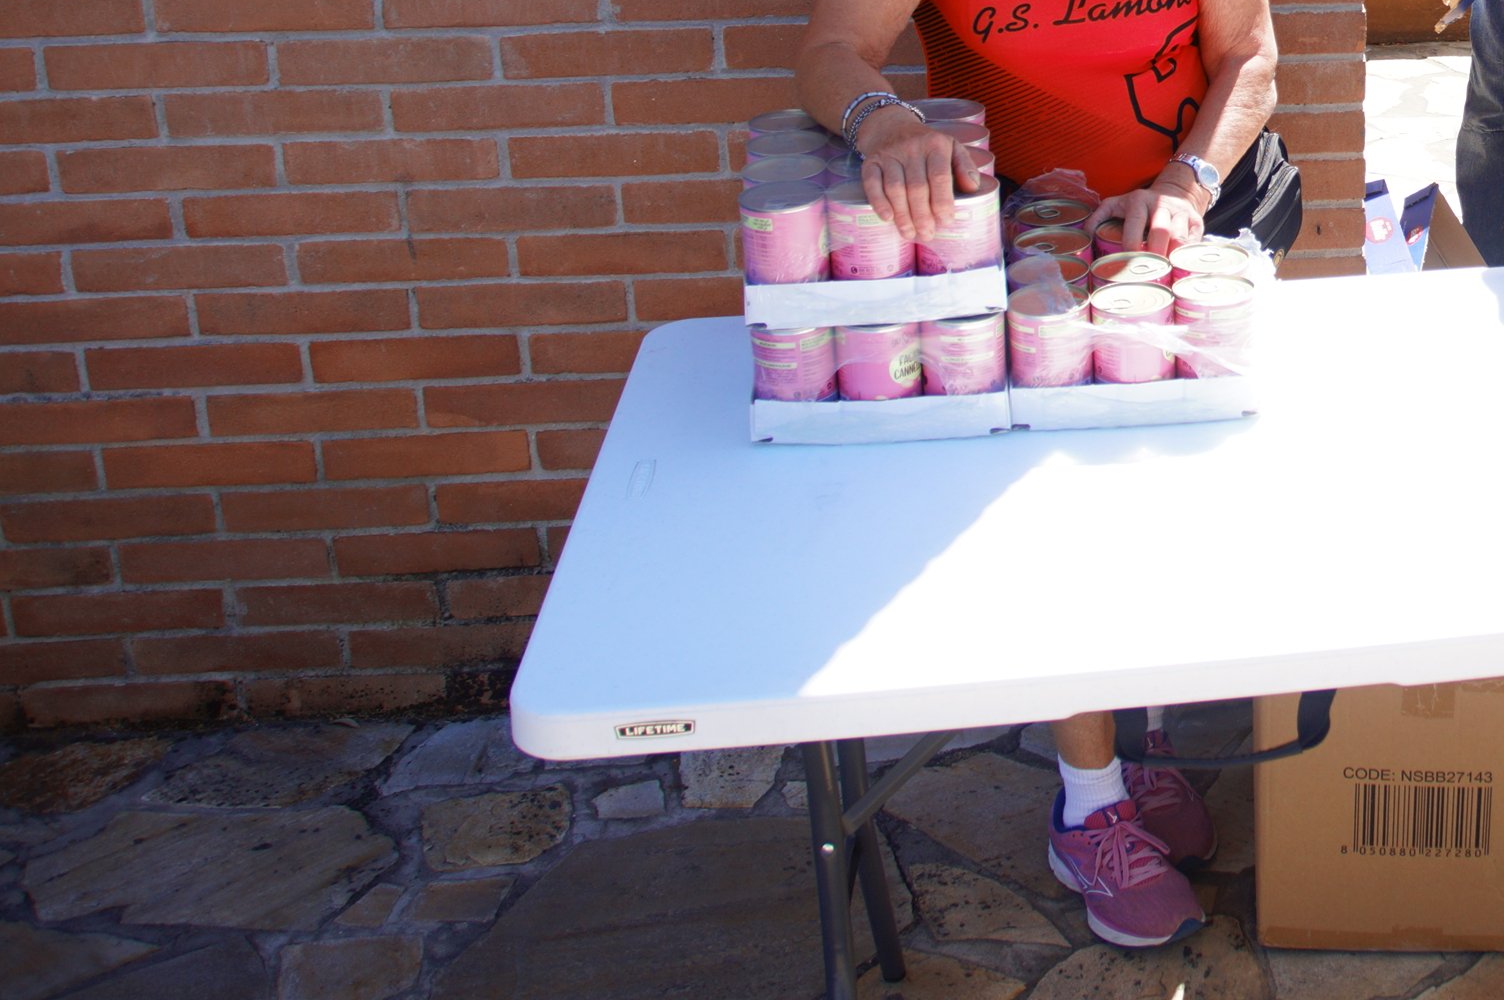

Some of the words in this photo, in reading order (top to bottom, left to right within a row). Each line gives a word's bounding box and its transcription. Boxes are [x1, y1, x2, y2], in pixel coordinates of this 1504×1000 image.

[972, 3, 1040, 43] G.S.
[625, 723, 685, 736] LIFETIME
[1343, 766, 1395, 782] CODE:
[1400, 769, 1493, 783] NSBB27143
